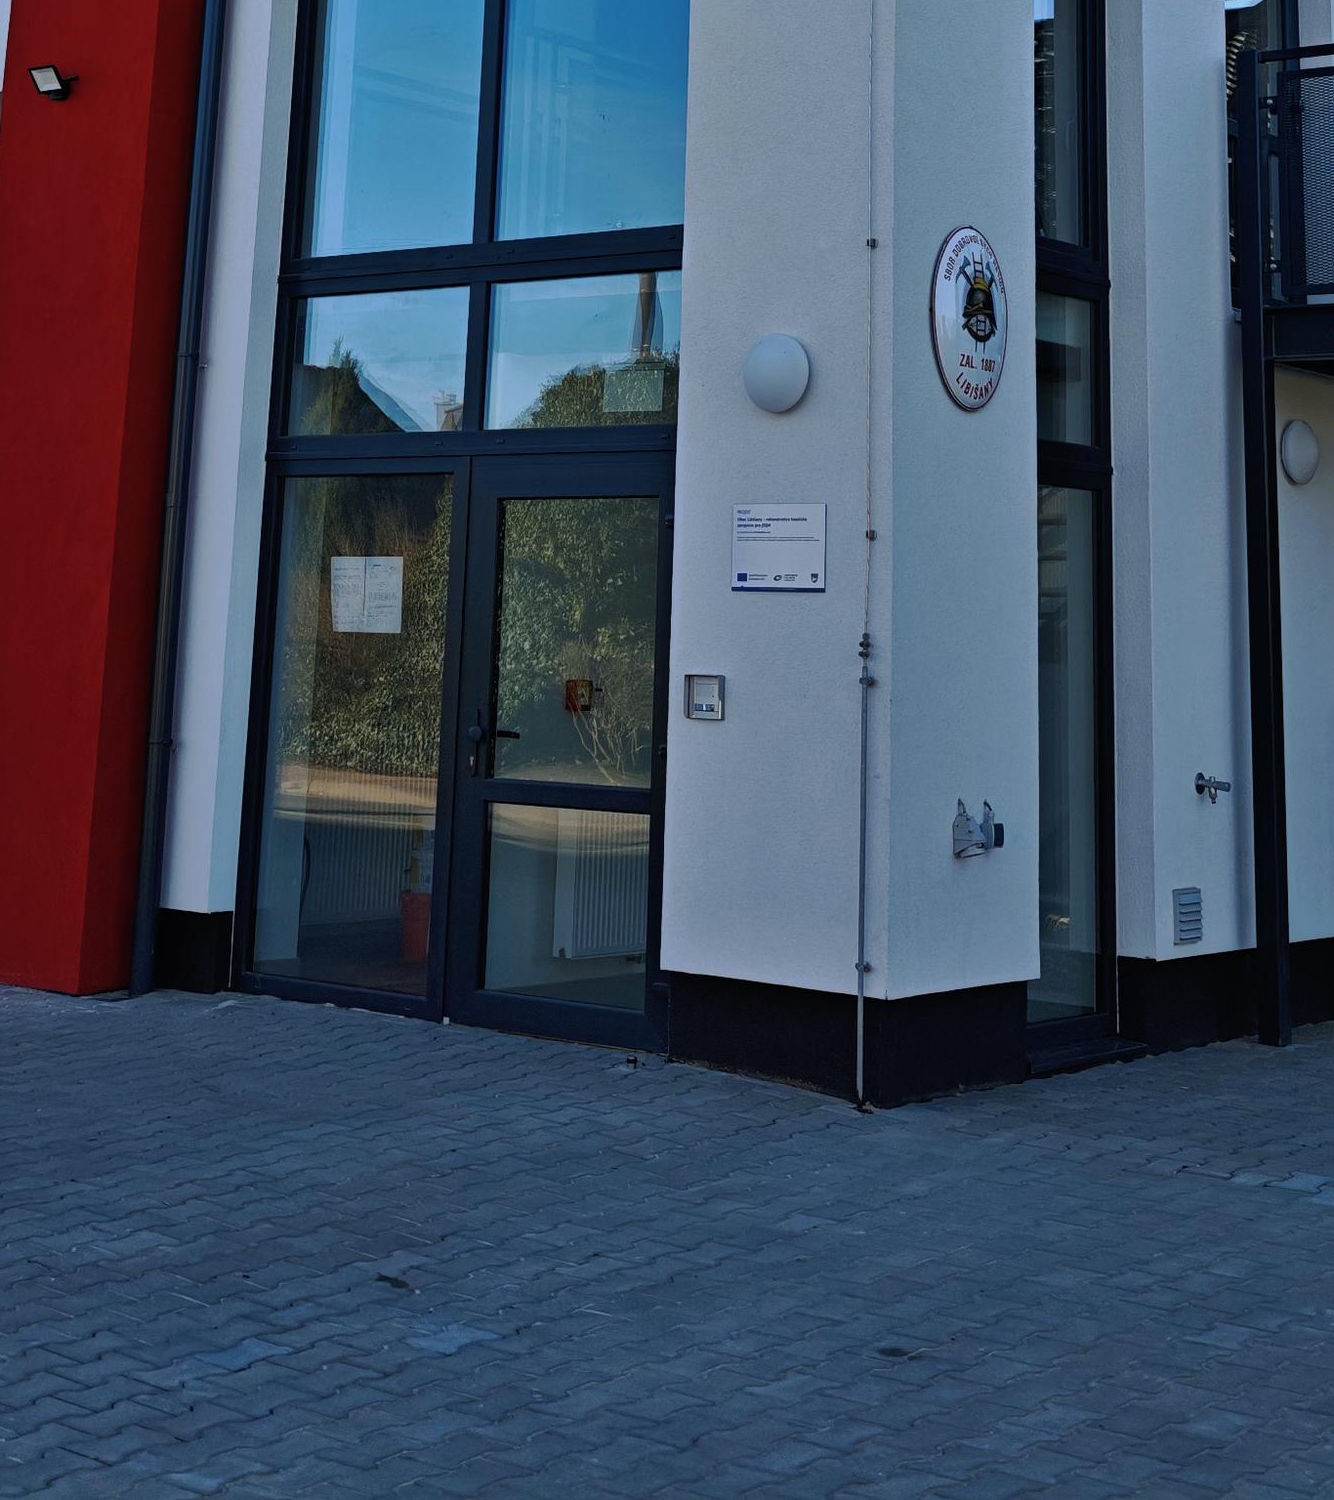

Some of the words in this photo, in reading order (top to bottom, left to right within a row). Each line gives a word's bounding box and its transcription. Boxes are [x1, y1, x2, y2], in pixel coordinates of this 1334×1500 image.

[943, 256, 956, 281] SBOR
[959, 353, 977, 369] ZAL.
[956, 371, 994, 400] LIBIŠANY
